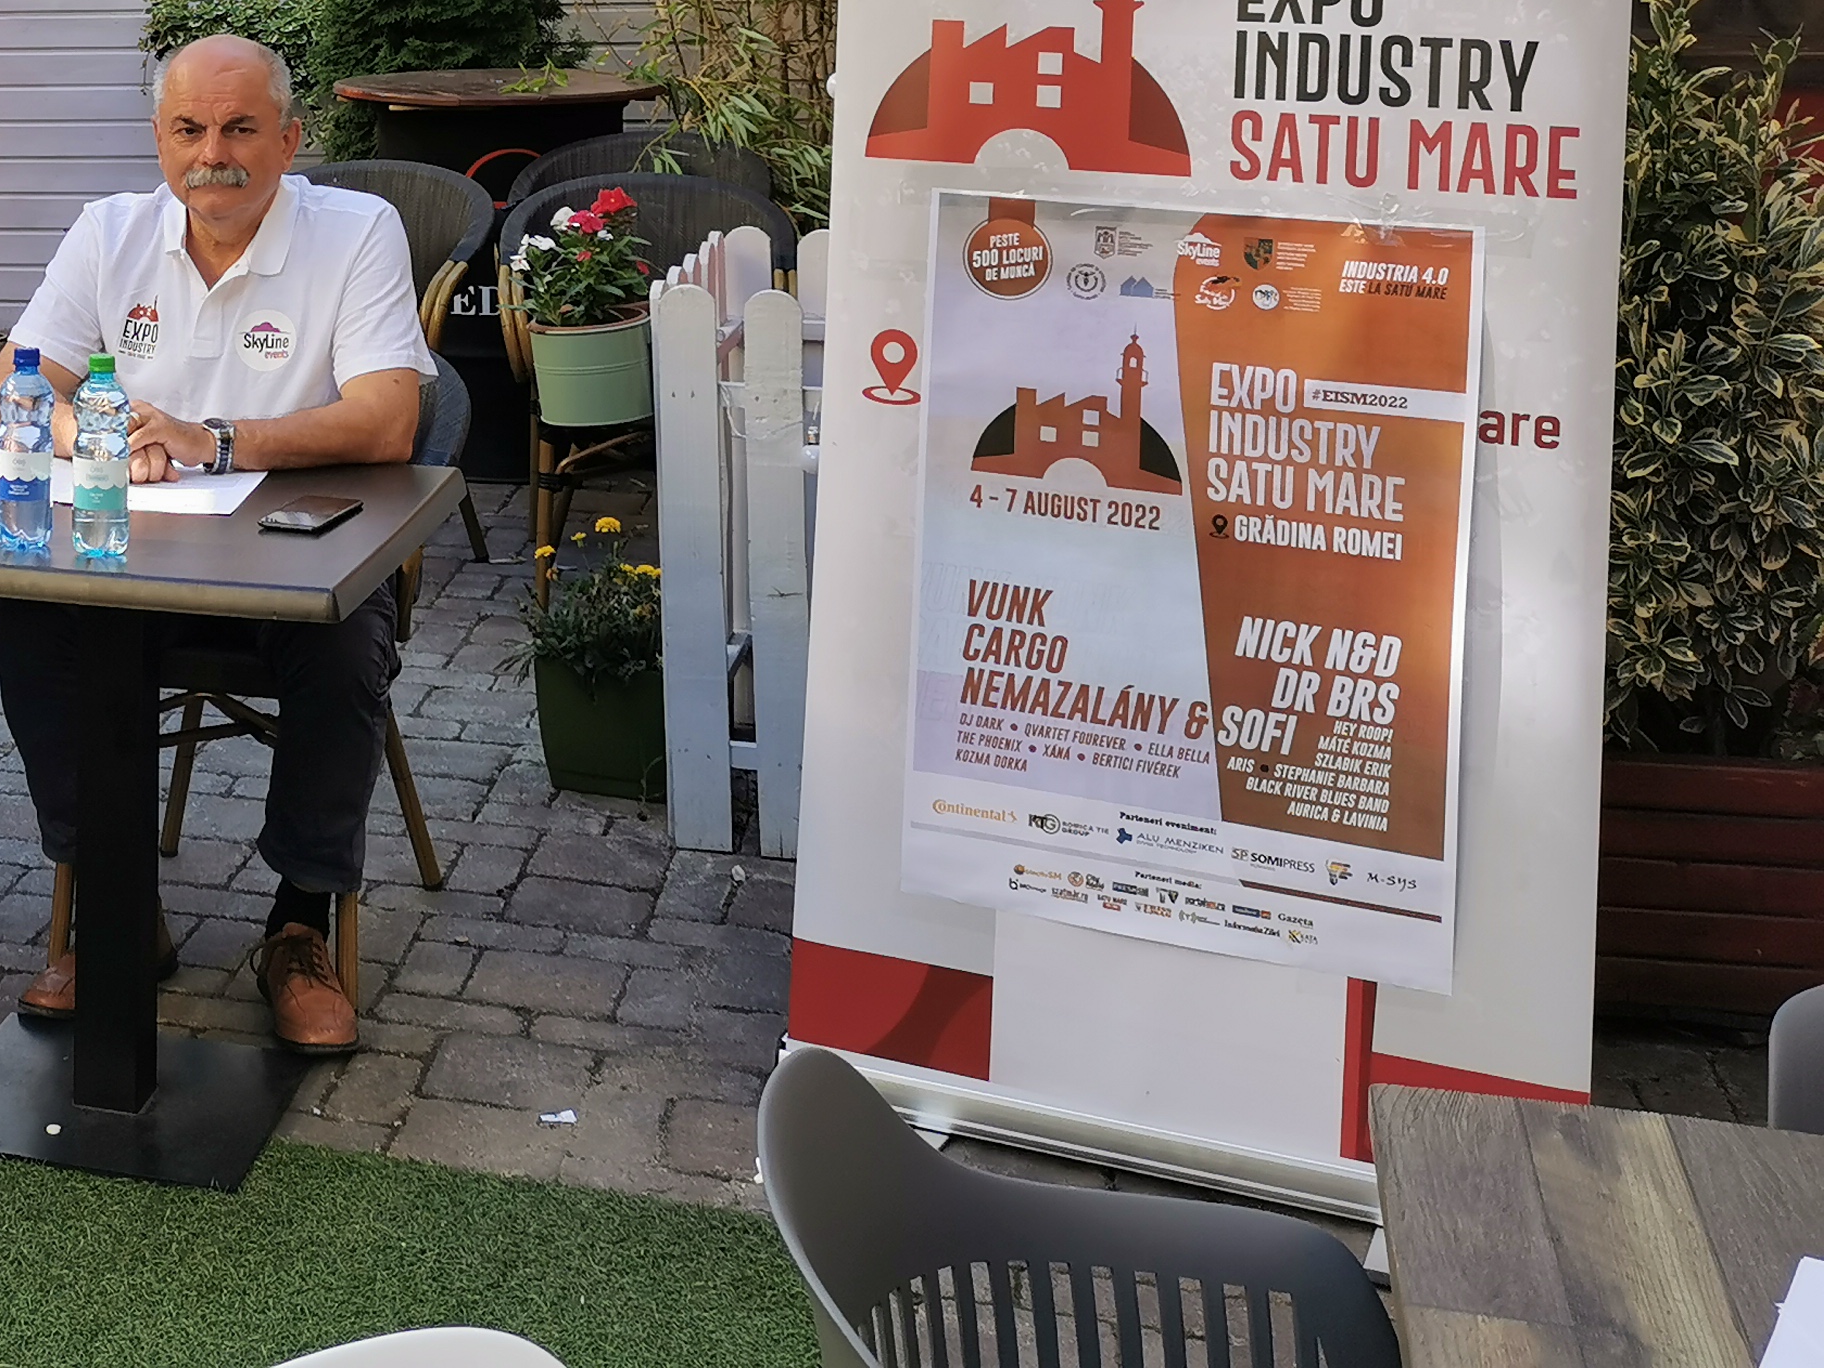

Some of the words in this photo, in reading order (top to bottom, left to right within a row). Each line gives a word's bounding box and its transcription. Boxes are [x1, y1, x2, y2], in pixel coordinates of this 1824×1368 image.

[1233, 30, 1541, 113] INDUSTRY
[1228, 109, 1380, 189] SATU
[1406, 119, 1581, 200] MARE
[989, 232, 1020, 249] PESTE
[1176, 241, 1220, 260] SkyLine
[972, 248, 999, 268] 500
[1002, 245, 1044, 265] LOCURI
[985, 267, 999, 281] DE
[1342, 260, 1419, 283] INDUSTRIA
[1421, 266, 1450, 285] 4.0
[1338, 279, 1366, 294] ESTE
[1367, 281, 1382, 296] LA
[1384, 282, 1414, 297] SATU
[1414, 283, 1449, 300] MARE
[122, 318, 159, 344] EXPO
[243, 331, 290, 353] SkyLine
[119, 338, 157, 355] INDUSTRY
[264, 350, 289, 360] events
[1210, 362, 1297, 414] EXPO
[1312, 388, 1408, 409] #EISM2022
[1208, 409, 1381, 469] INDUSTRY
[1206, 457, 1294, 510] SATU
[1306, 468, 1406, 522] MARE
[969, 484, 983, 509] 4
[1005, 488, 1018, 512] 7
[1023, 490, 1101, 523] AUGUST
[1107, 500, 1161, 531] 2022
[1234, 514, 1327, 552] GRĂDINA
[1332, 526, 1403, 561] ROMEI
[966, 578, 1054, 629] VUNK
[962, 623, 1068, 675] CARGO
[1234, 615, 1322, 667] NICK
[1324, 628, 1404, 679] N&D
[1269, 667, 1320, 713] DR
[1326, 676, 1401, 725] BRS
[960, 666, 1181, 736] NEMAZALÁNY
[1184, 699, 1209, 741] &
[1217, 704, 1298, 756] SOFI
[959, 712, 974, 727] DJ
[976, 715, 1005, 731] DARK
[1025, 722, 1071, 743] QVARTET
[1072, 730, 1126, 751] FOUREVER
[1148, 742, 1174, 759] ELLA
[1177, 747, 1211, 765] BELLA
[1333, 720, 1355, 737] HEY
[1358, 724, 1394, 743] ROOP!
[955, 748, 991, 766] KOZMA
[993, 754, 1028, 773] DORKA
[957, 730, 976, 746] THE
[978, 734, 1023, 753] PHOENIX
[1042, 742, 1071, 761] XÁNÁ
[1092, 751, 1134, 771] BERTICI
[1135, 758, 1181, 779] FIVÉREK
[1317, 735, 1351, 754] MÁTÉ
[1352, 741, 1392, 761] KOZMA
[1227, 756, 1255, 774] ARIS
[1273, 764, 1335, 786] STEPHANIE
[1337, 774, 1390, 797] BARBARA
[1314, 753, 1361, 774] SZLABIK
[1364, 761, 1392, 779] ERIK
[1245, 776, 1282, 796] BLACK
[1284, 783, 1318, 803] RIVER
[1319, 788, 1357, 808] BLUES
[1358, 795, 1390, 815] BAND
[932, 798, 1007, 823] Continental
[1119, 811, 1163, 827] Parteneri
[1287, 800, 1329, 822] AURICA
[1331, 808, 1341, 824] &
[1343, 810, 1389, 832] LAVINIA
[1137, 832, 1160, 843] ALU
[1164, 837, 1224, 854] MENZIKEN
[1231, 846, 1249, 861] SP
[1250, 852, 1316, 874] SOMIPRESS
